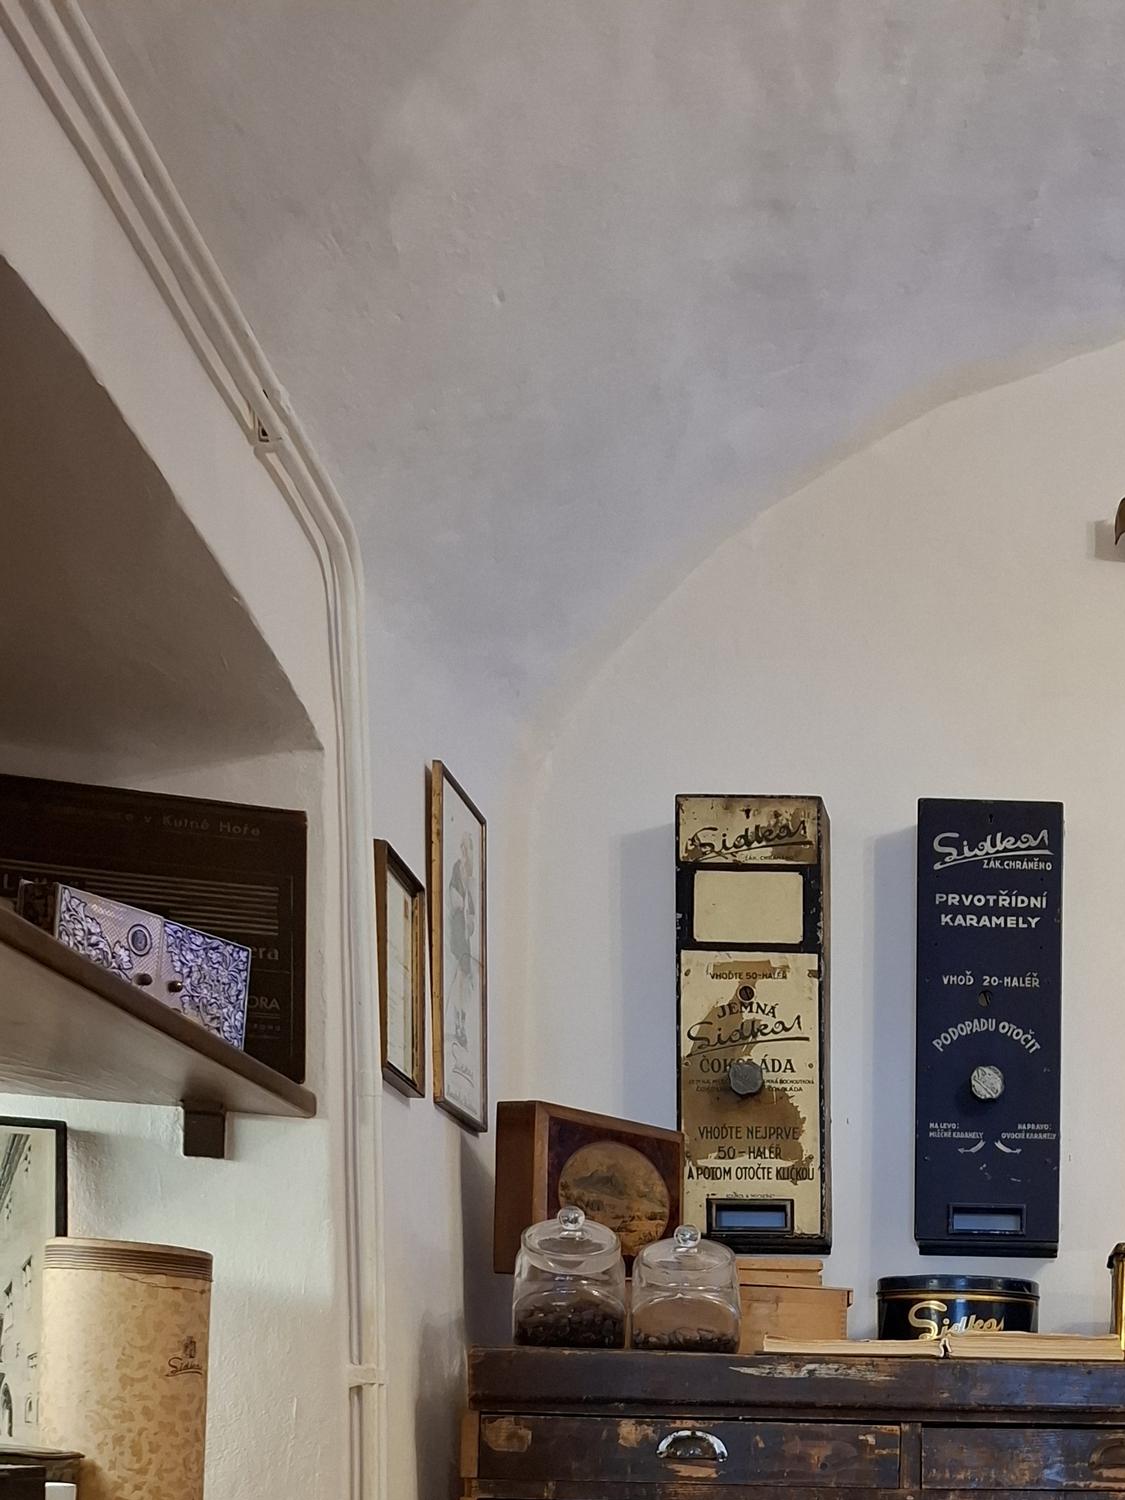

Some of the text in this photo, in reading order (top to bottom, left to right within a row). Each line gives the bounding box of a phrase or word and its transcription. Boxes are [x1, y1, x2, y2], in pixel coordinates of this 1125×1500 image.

[935, 890, 1048, 909] PRVOTŘÍDNÍ
[940, 913, 1041, 928] KARAMELY
[942, 970, 975, 986] VHOĎ
[717, 1001, 779, 1019] JEMNÁ
[998, 1021, 1041, 1054] OTOČIT
[700, 1054, 796, 1073] ČOKÁDA
[698, 1124, 800, 1141] VHOĎTE NEJPRVE
[696, 1166, 732, 1180] POTOM
[735, 1163, 773, 1180] OTOČTE
